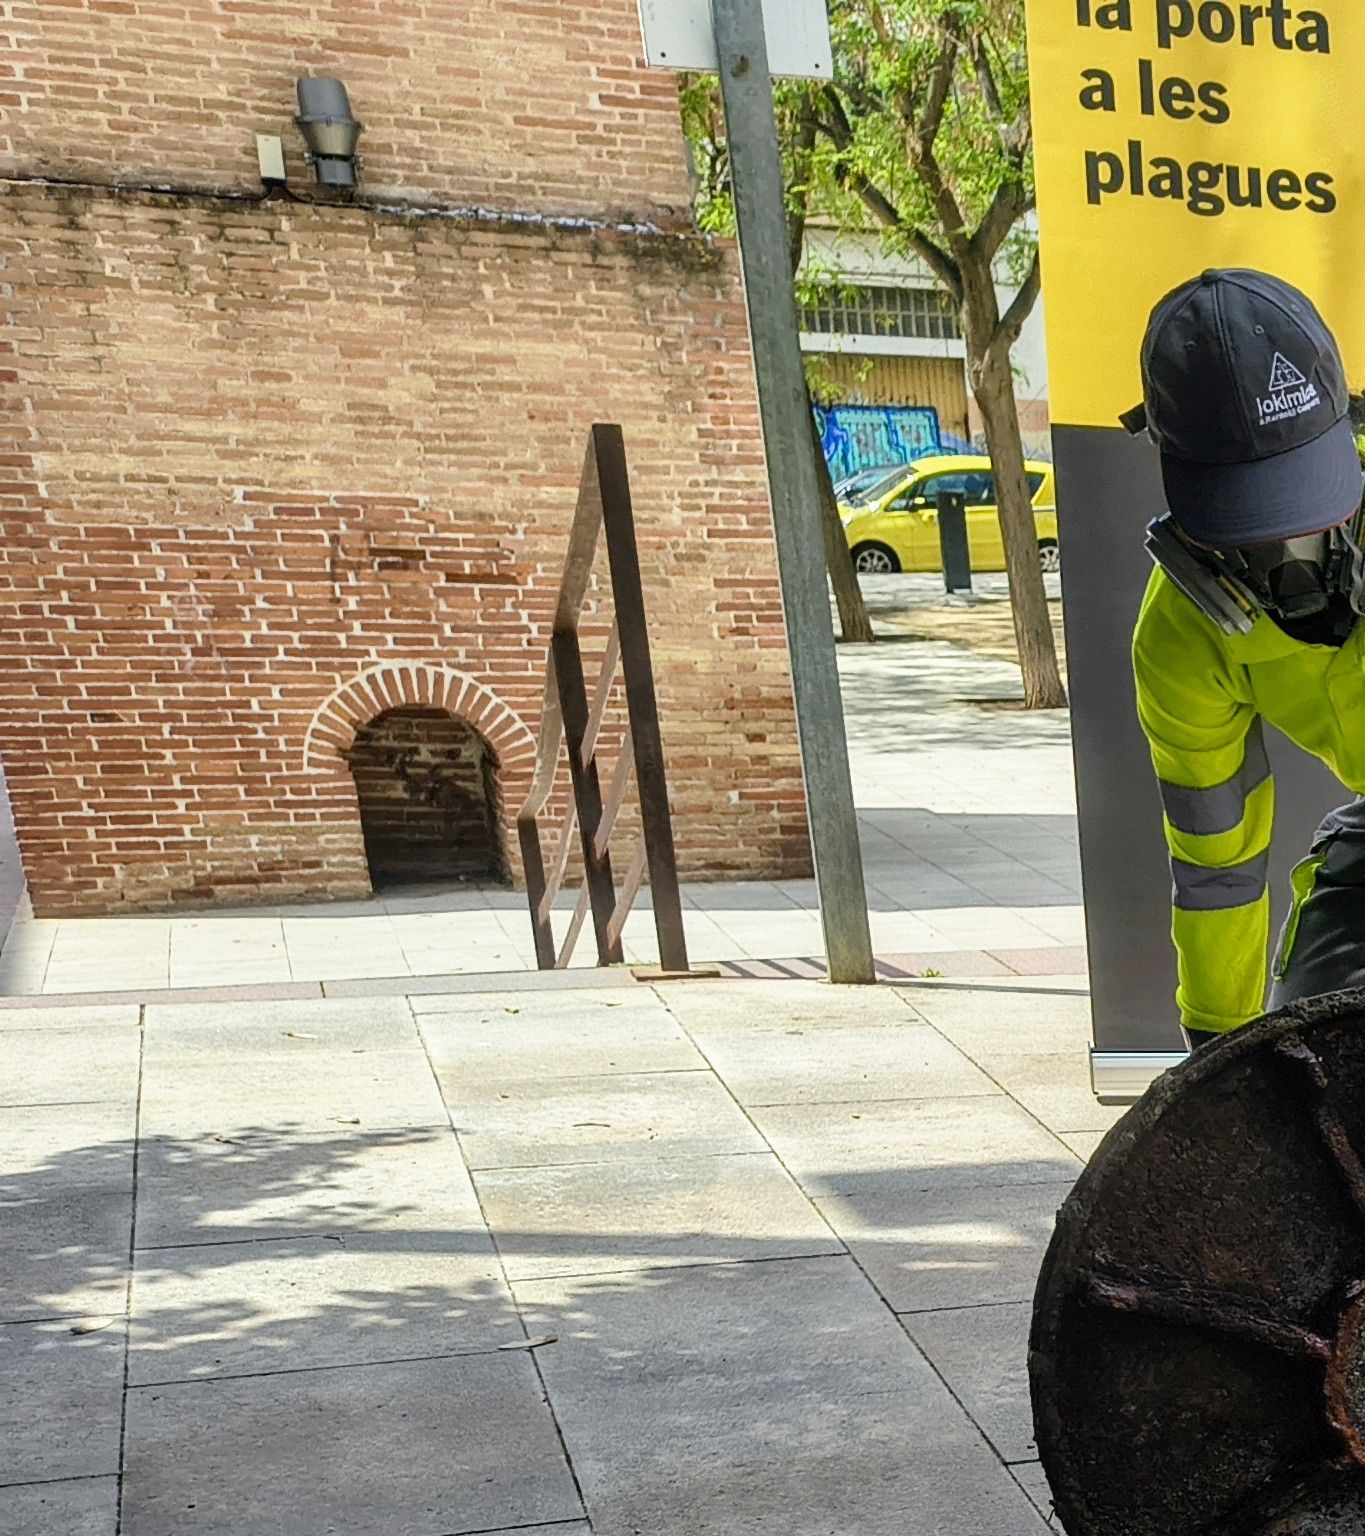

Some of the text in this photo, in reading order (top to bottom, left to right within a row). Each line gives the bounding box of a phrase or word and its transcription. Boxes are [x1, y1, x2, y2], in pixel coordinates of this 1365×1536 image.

[1155, 0, 1331, 54] porta
[1079, 58, 1230, 125] a les
[1084, 139, 1337, 217] plagues
